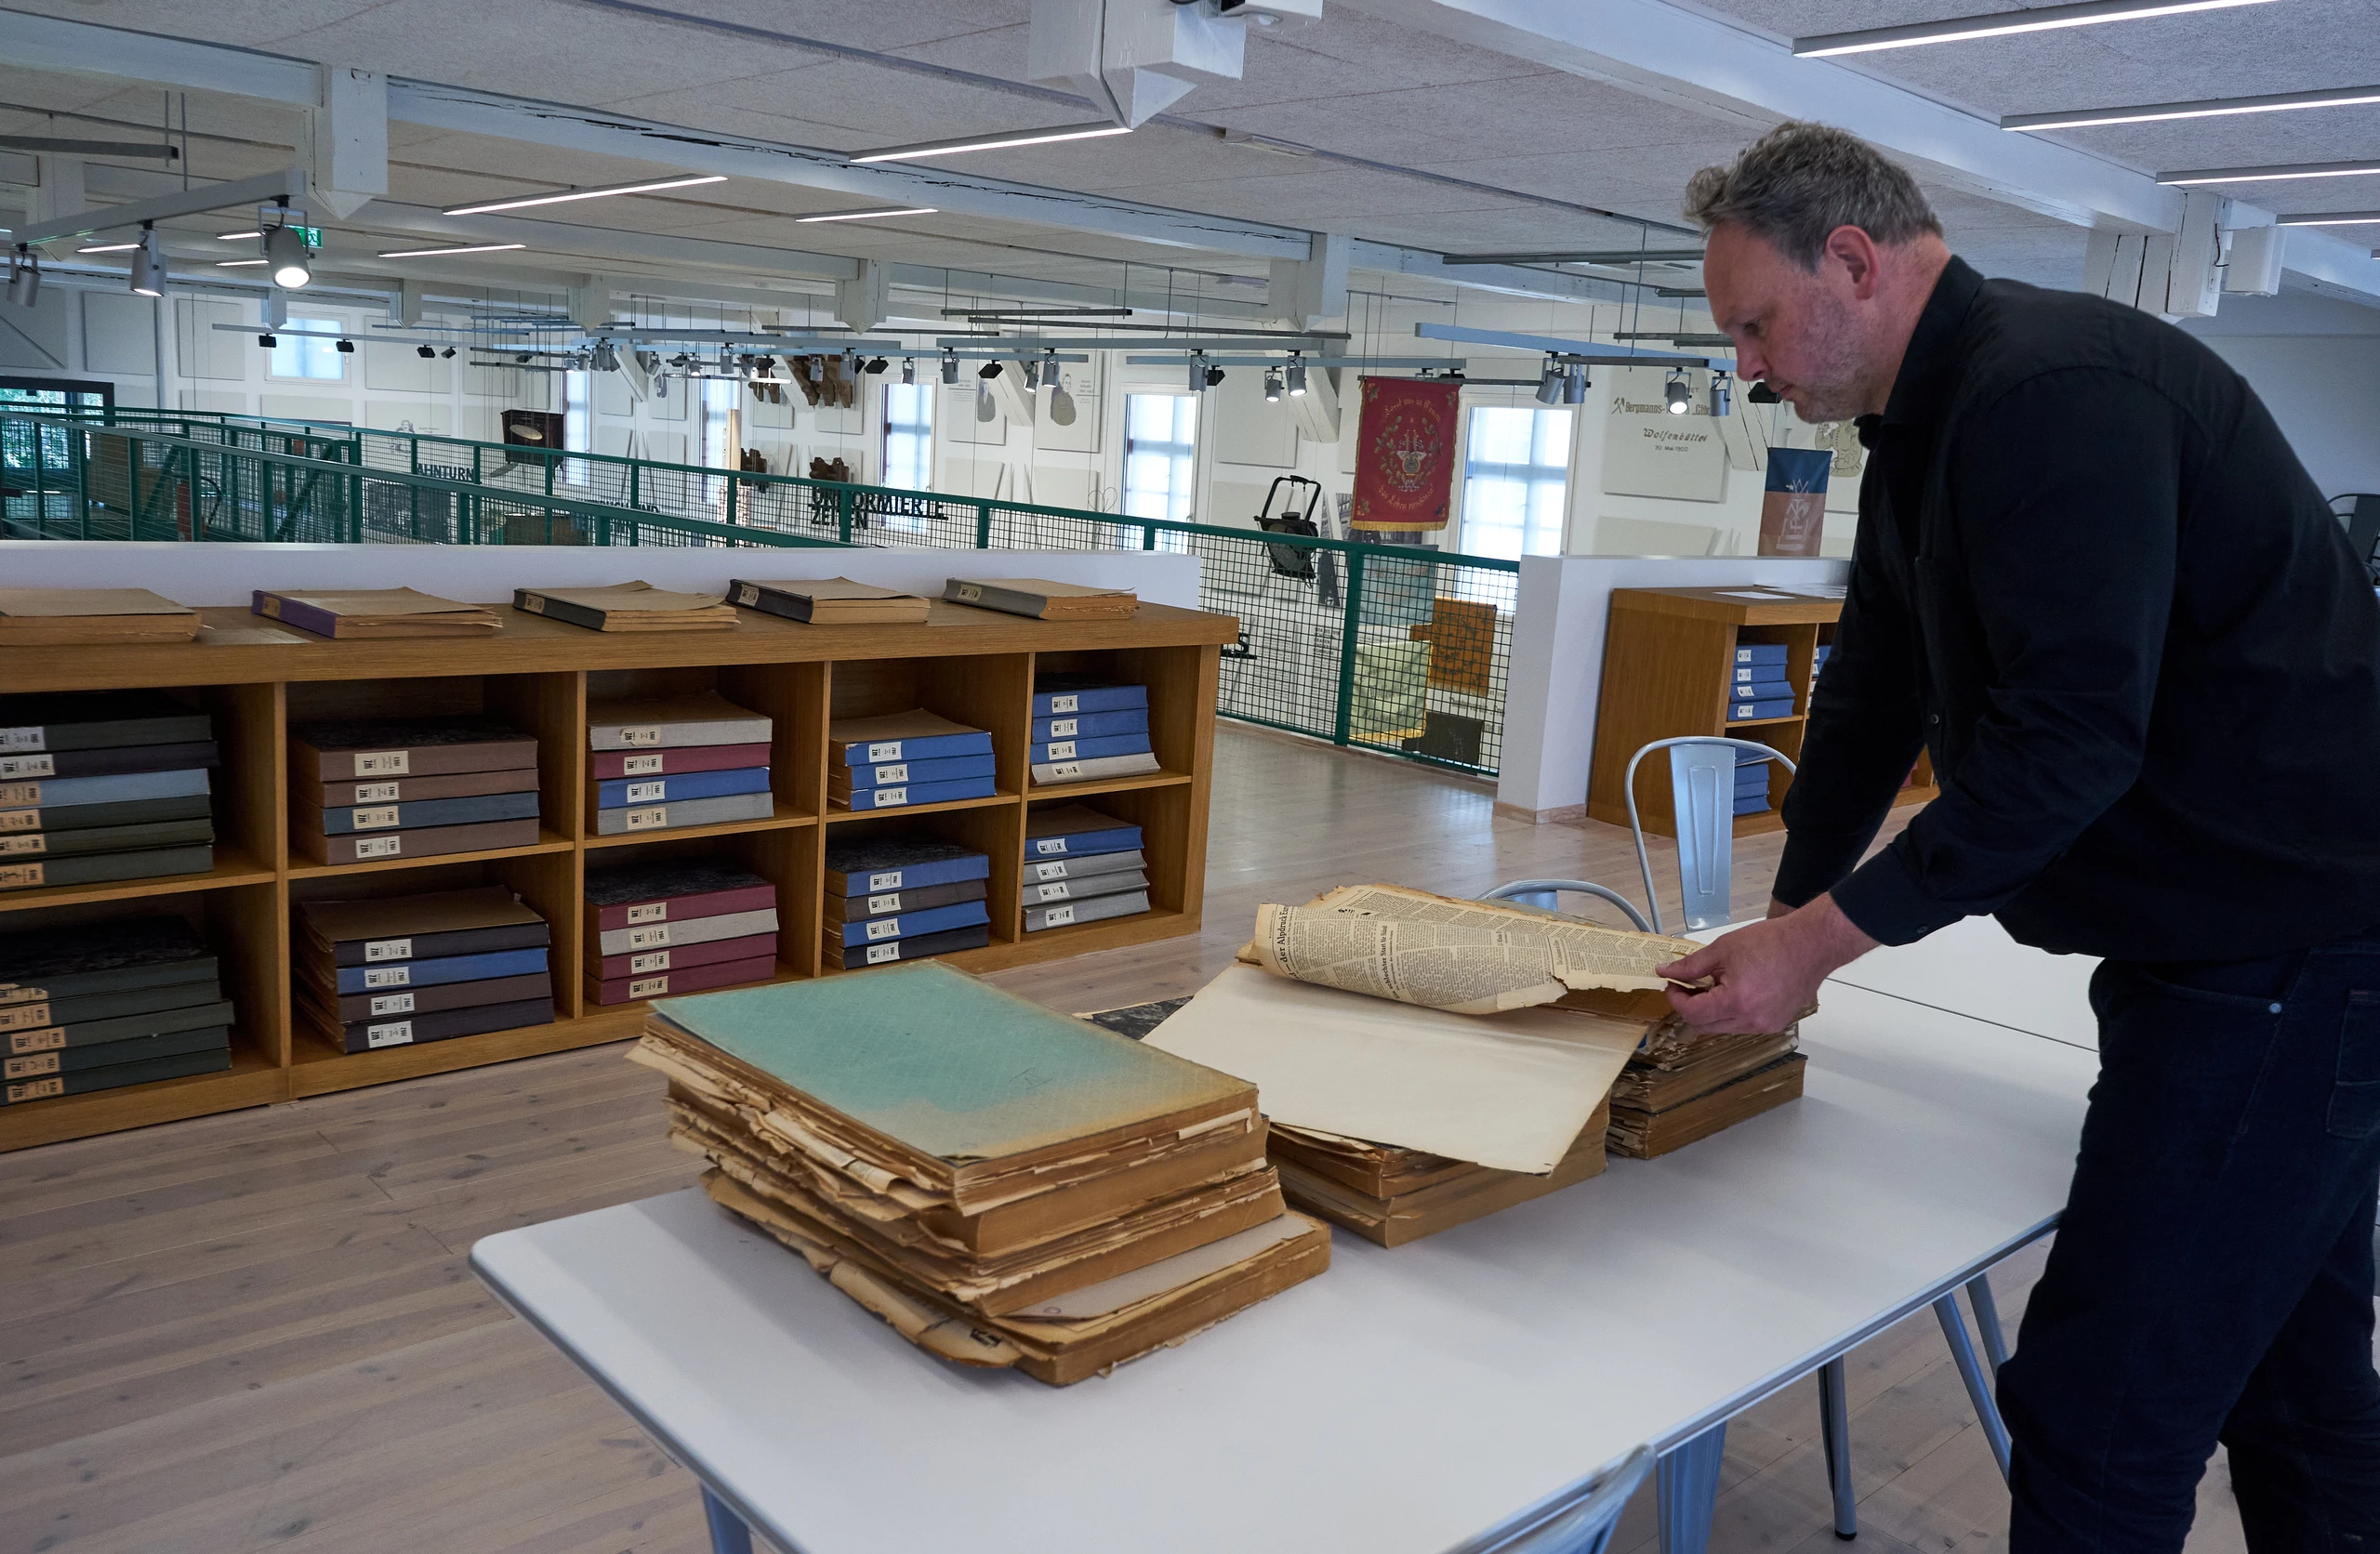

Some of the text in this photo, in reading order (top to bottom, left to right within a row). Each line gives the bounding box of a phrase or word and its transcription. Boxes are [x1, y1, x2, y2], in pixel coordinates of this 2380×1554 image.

[1625, 402, 1665, 414] Bergmanns-
[1644, 428, 1708, 441] Wolfenbüttel
[811, 507, 868, 530] ZEIEN
[3, 762, 15, 772] WZ
[364, 760, 373, 769] WZ
[359, 790, 367, 798] WZ
[631, 787, 639, 796] WZ
[358, 814, 366, 823] WZ
[631, 815, 639, 823] WZ
[361, 845, 369, 853] WZ
[1276, 915, 1288, 945] Alpdruck
[371, 948, 379, 956] WZ
[1279, 947, 1289, 963] der
[635, 959, 641, 968] WZ
[1382, 956, 1393, 990] schlechter
[368, 975, 377, 983] WZ
[375, 1002, 383, 1010] WZ
[371, 1031, 380, 1040] WZ
[16, 1038, 26, 1047] WZ
[10, 1063, 21, 1072] WZ
[13, 1088, 22, 1098] WZ
